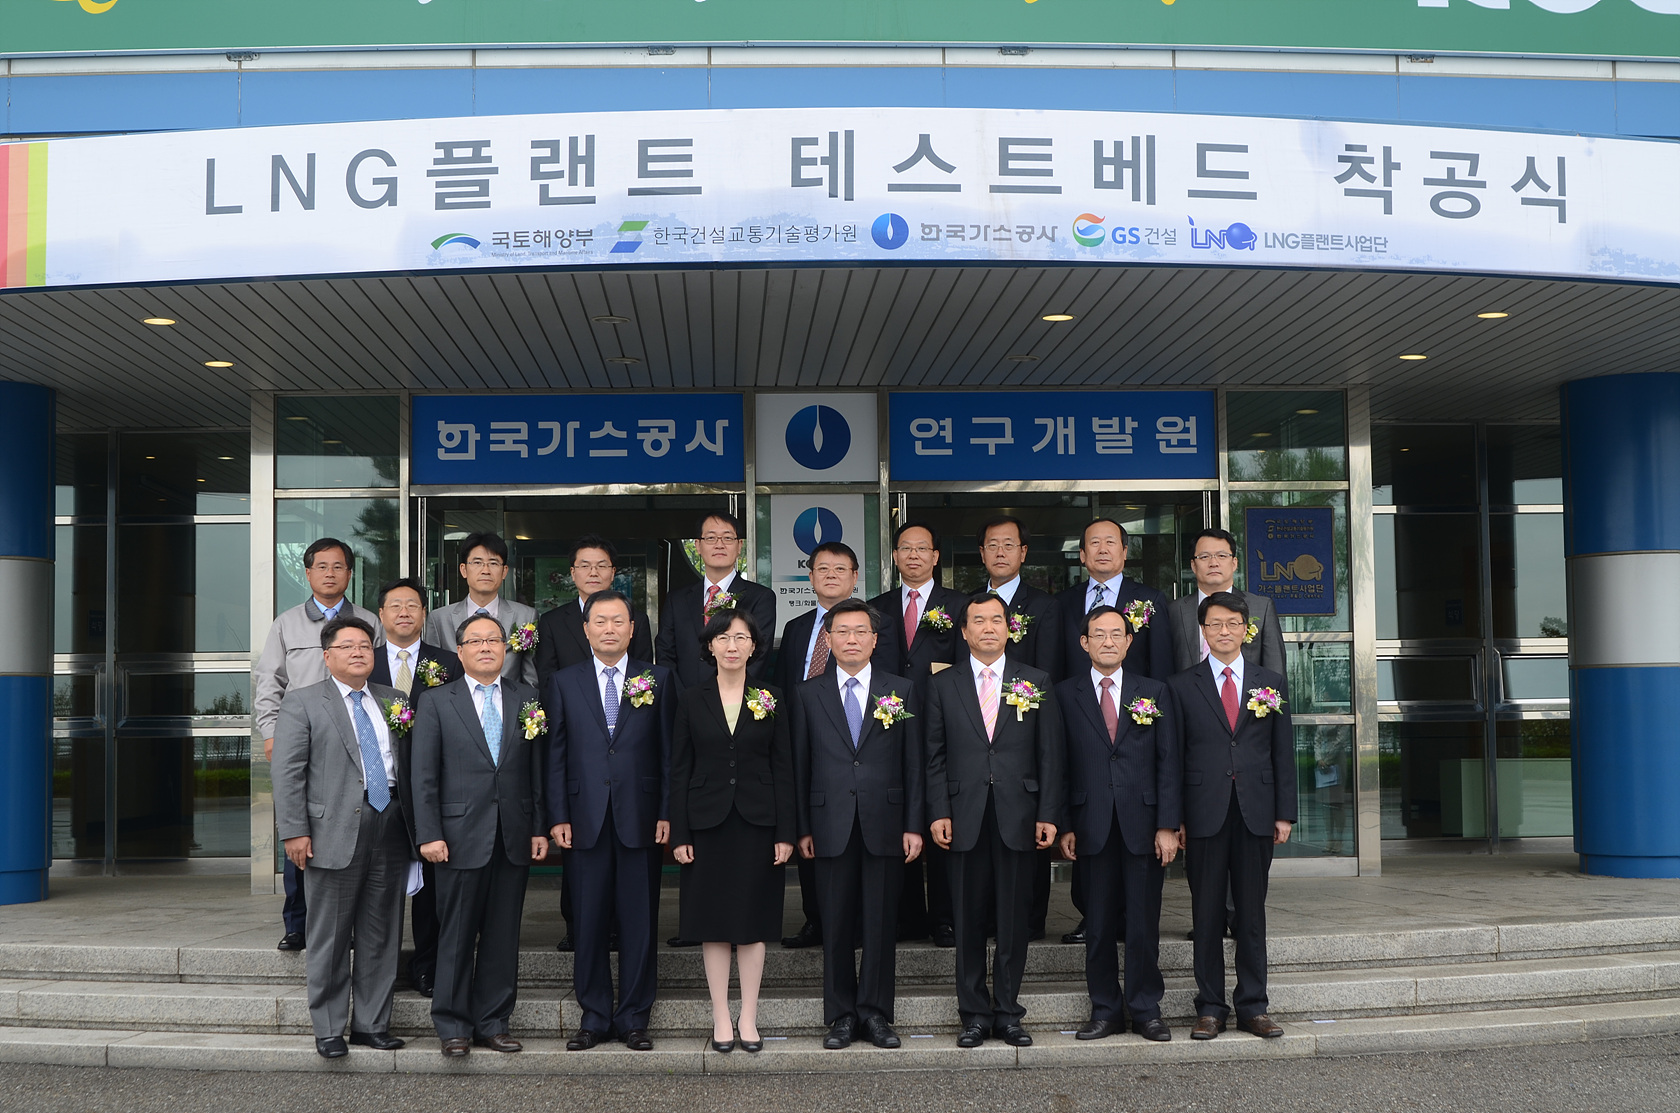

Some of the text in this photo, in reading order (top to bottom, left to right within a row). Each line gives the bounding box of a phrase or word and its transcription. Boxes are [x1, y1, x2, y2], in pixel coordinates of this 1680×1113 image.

[205, 129, 1567, 224] LNG플랜트 테스트베드 착공식
[491, 229, 594, 249] 국토해양부
[653, 224, 858, 245] 한국건설교통기술평가원
[920, 222, 1058, 243] 한국가스공사
[1111, 226, 1177, 246] GS 건설
[1264, 232, 1388, 253] LNG플랜트사업단
[437, 419, 729, 461] 한국가스공사
[909, 416, 1198, 456] 연구개발원
